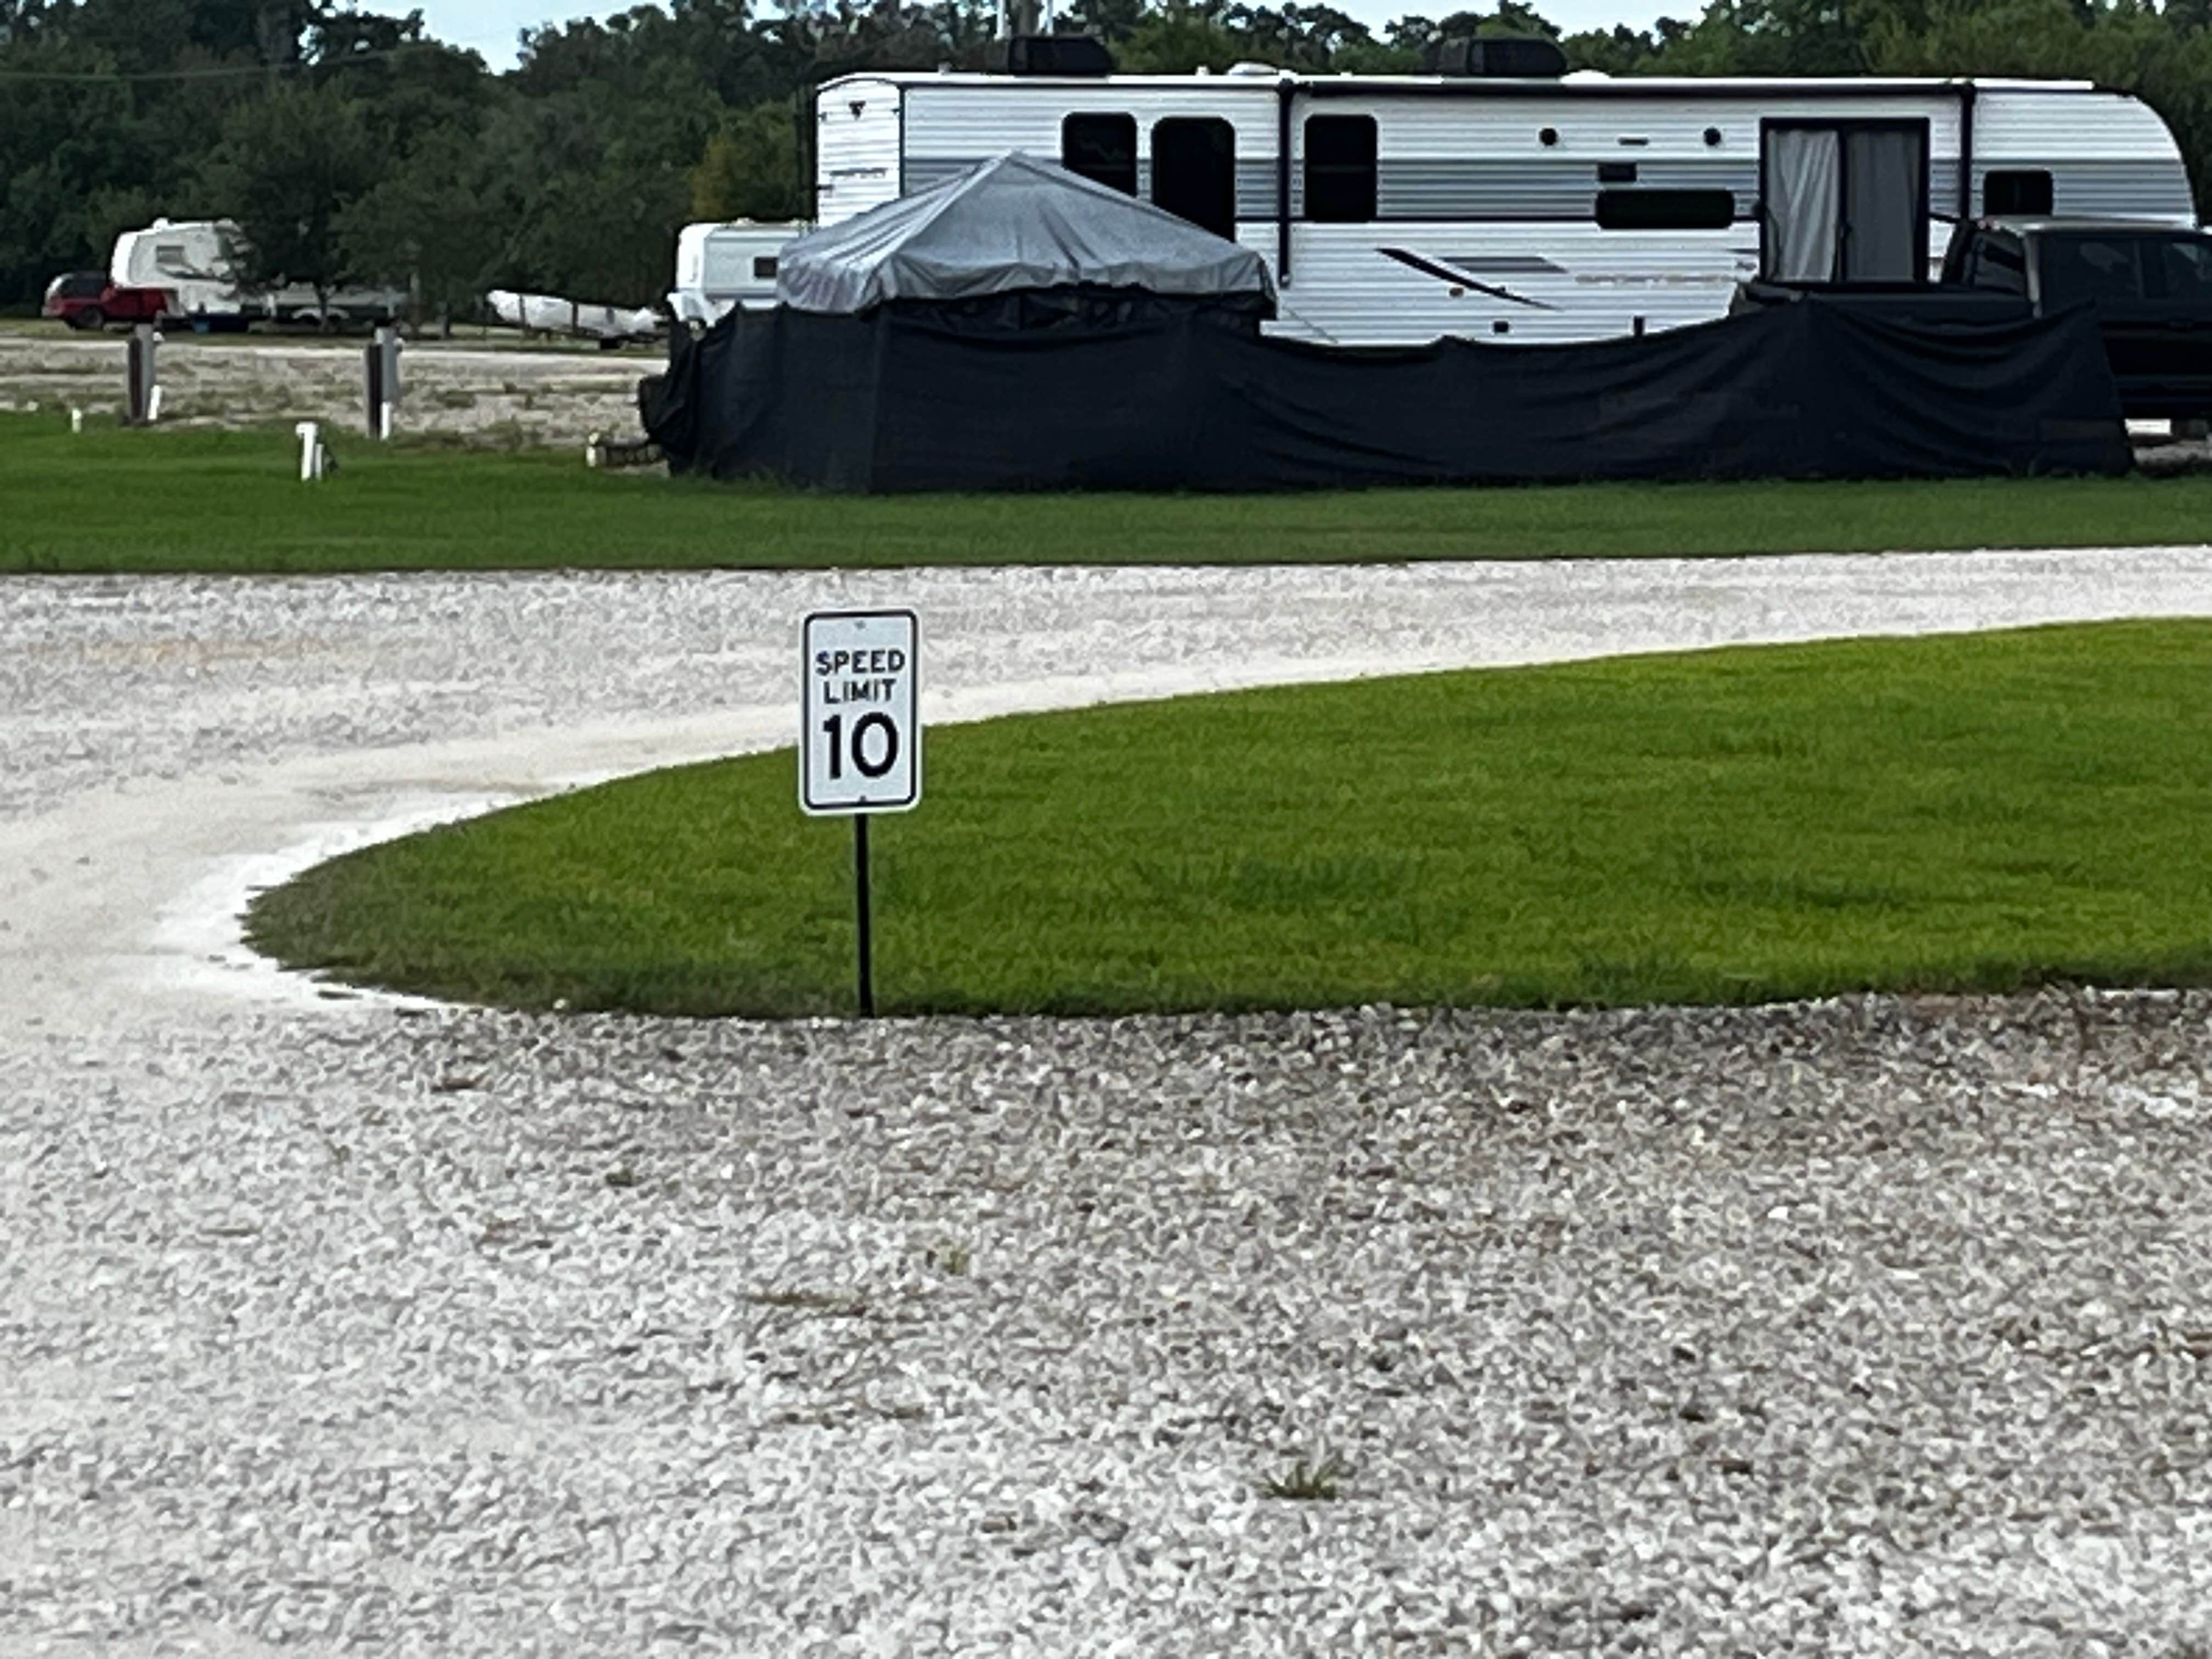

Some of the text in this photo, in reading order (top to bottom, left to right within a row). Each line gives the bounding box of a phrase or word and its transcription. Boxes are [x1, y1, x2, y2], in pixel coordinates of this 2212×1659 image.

[815, 649, 905, 676] SPEED
[823, 678, 897, 704] LIMIT
[823, 712, 899, 779] 10
